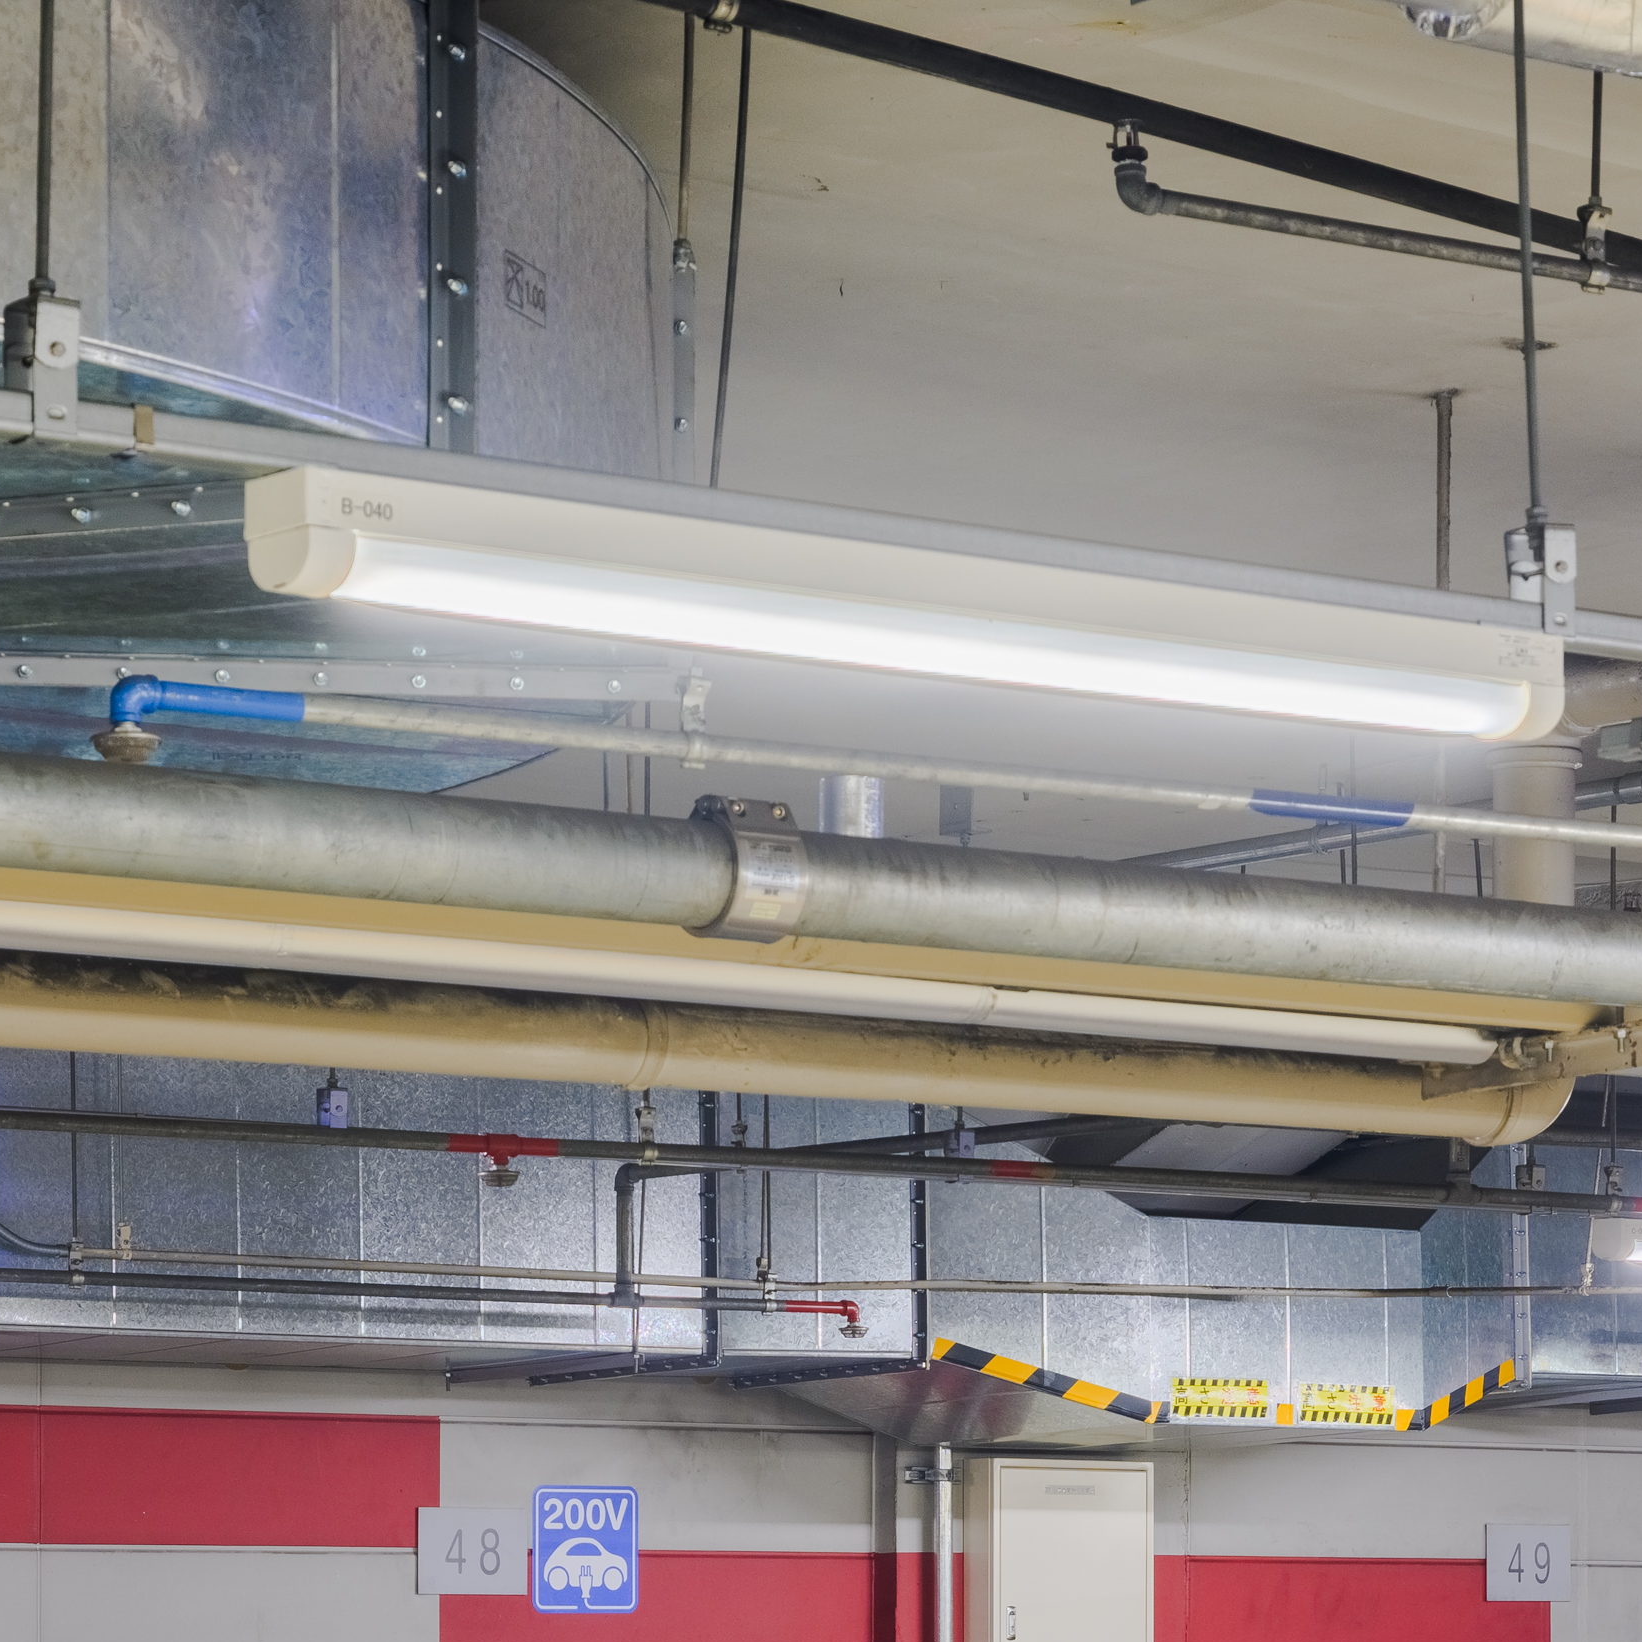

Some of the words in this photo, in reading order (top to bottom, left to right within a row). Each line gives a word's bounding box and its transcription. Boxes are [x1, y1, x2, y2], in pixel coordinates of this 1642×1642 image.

[340, 496, 394, 521] B-040
[543, 1497, 630, 1532] 200V
[444, 1528, 502, 1577] 48
[1507, 1542, 1552, 1585] 49
